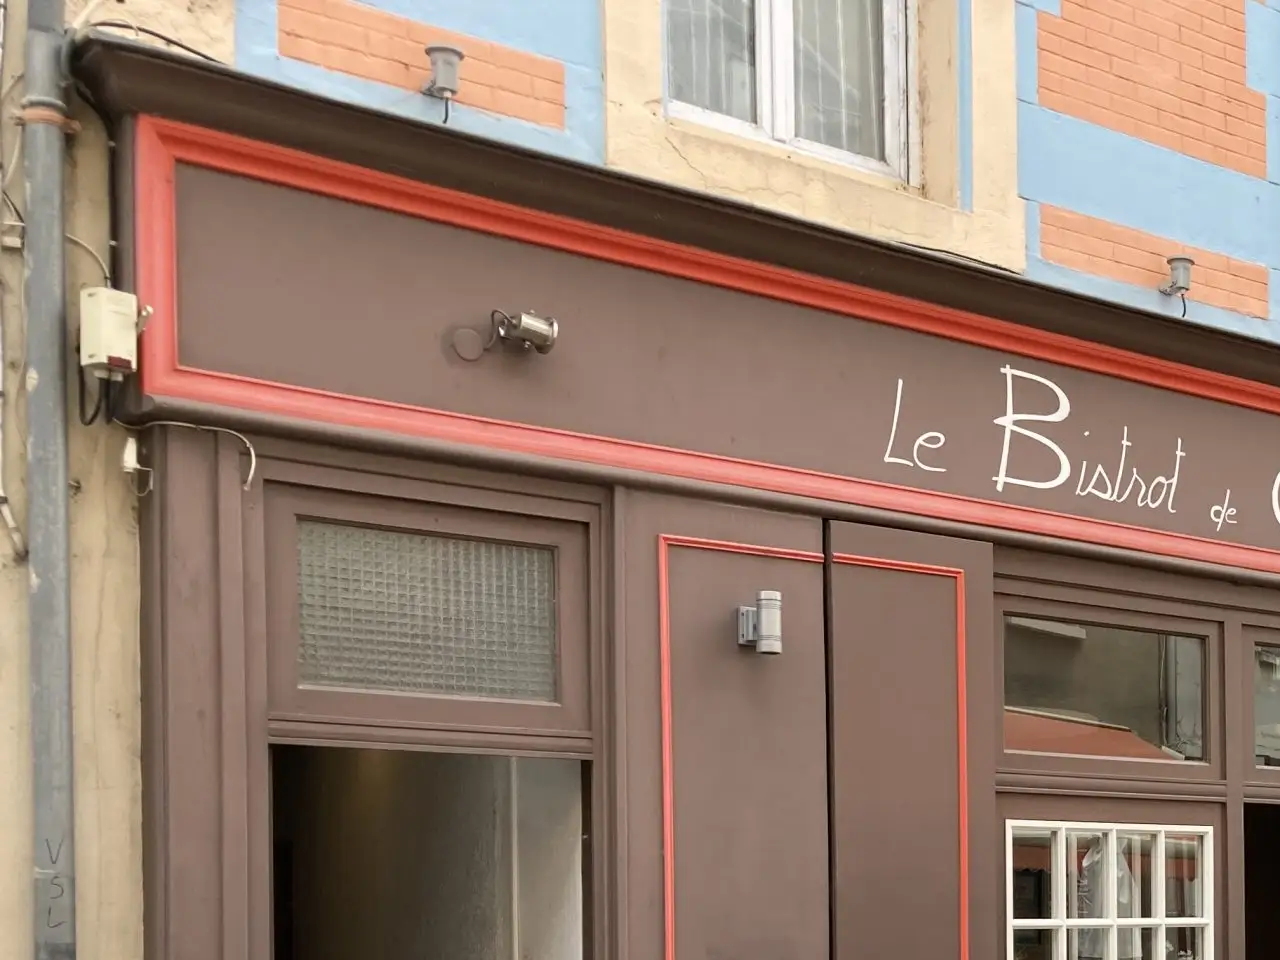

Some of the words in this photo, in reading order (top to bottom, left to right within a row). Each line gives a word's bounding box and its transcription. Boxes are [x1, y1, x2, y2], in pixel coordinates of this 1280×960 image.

[883, 378, 947, 473] Le
[992, 363, 1186, 513] Bistrot
[1209, 488, 1238, 533] de
